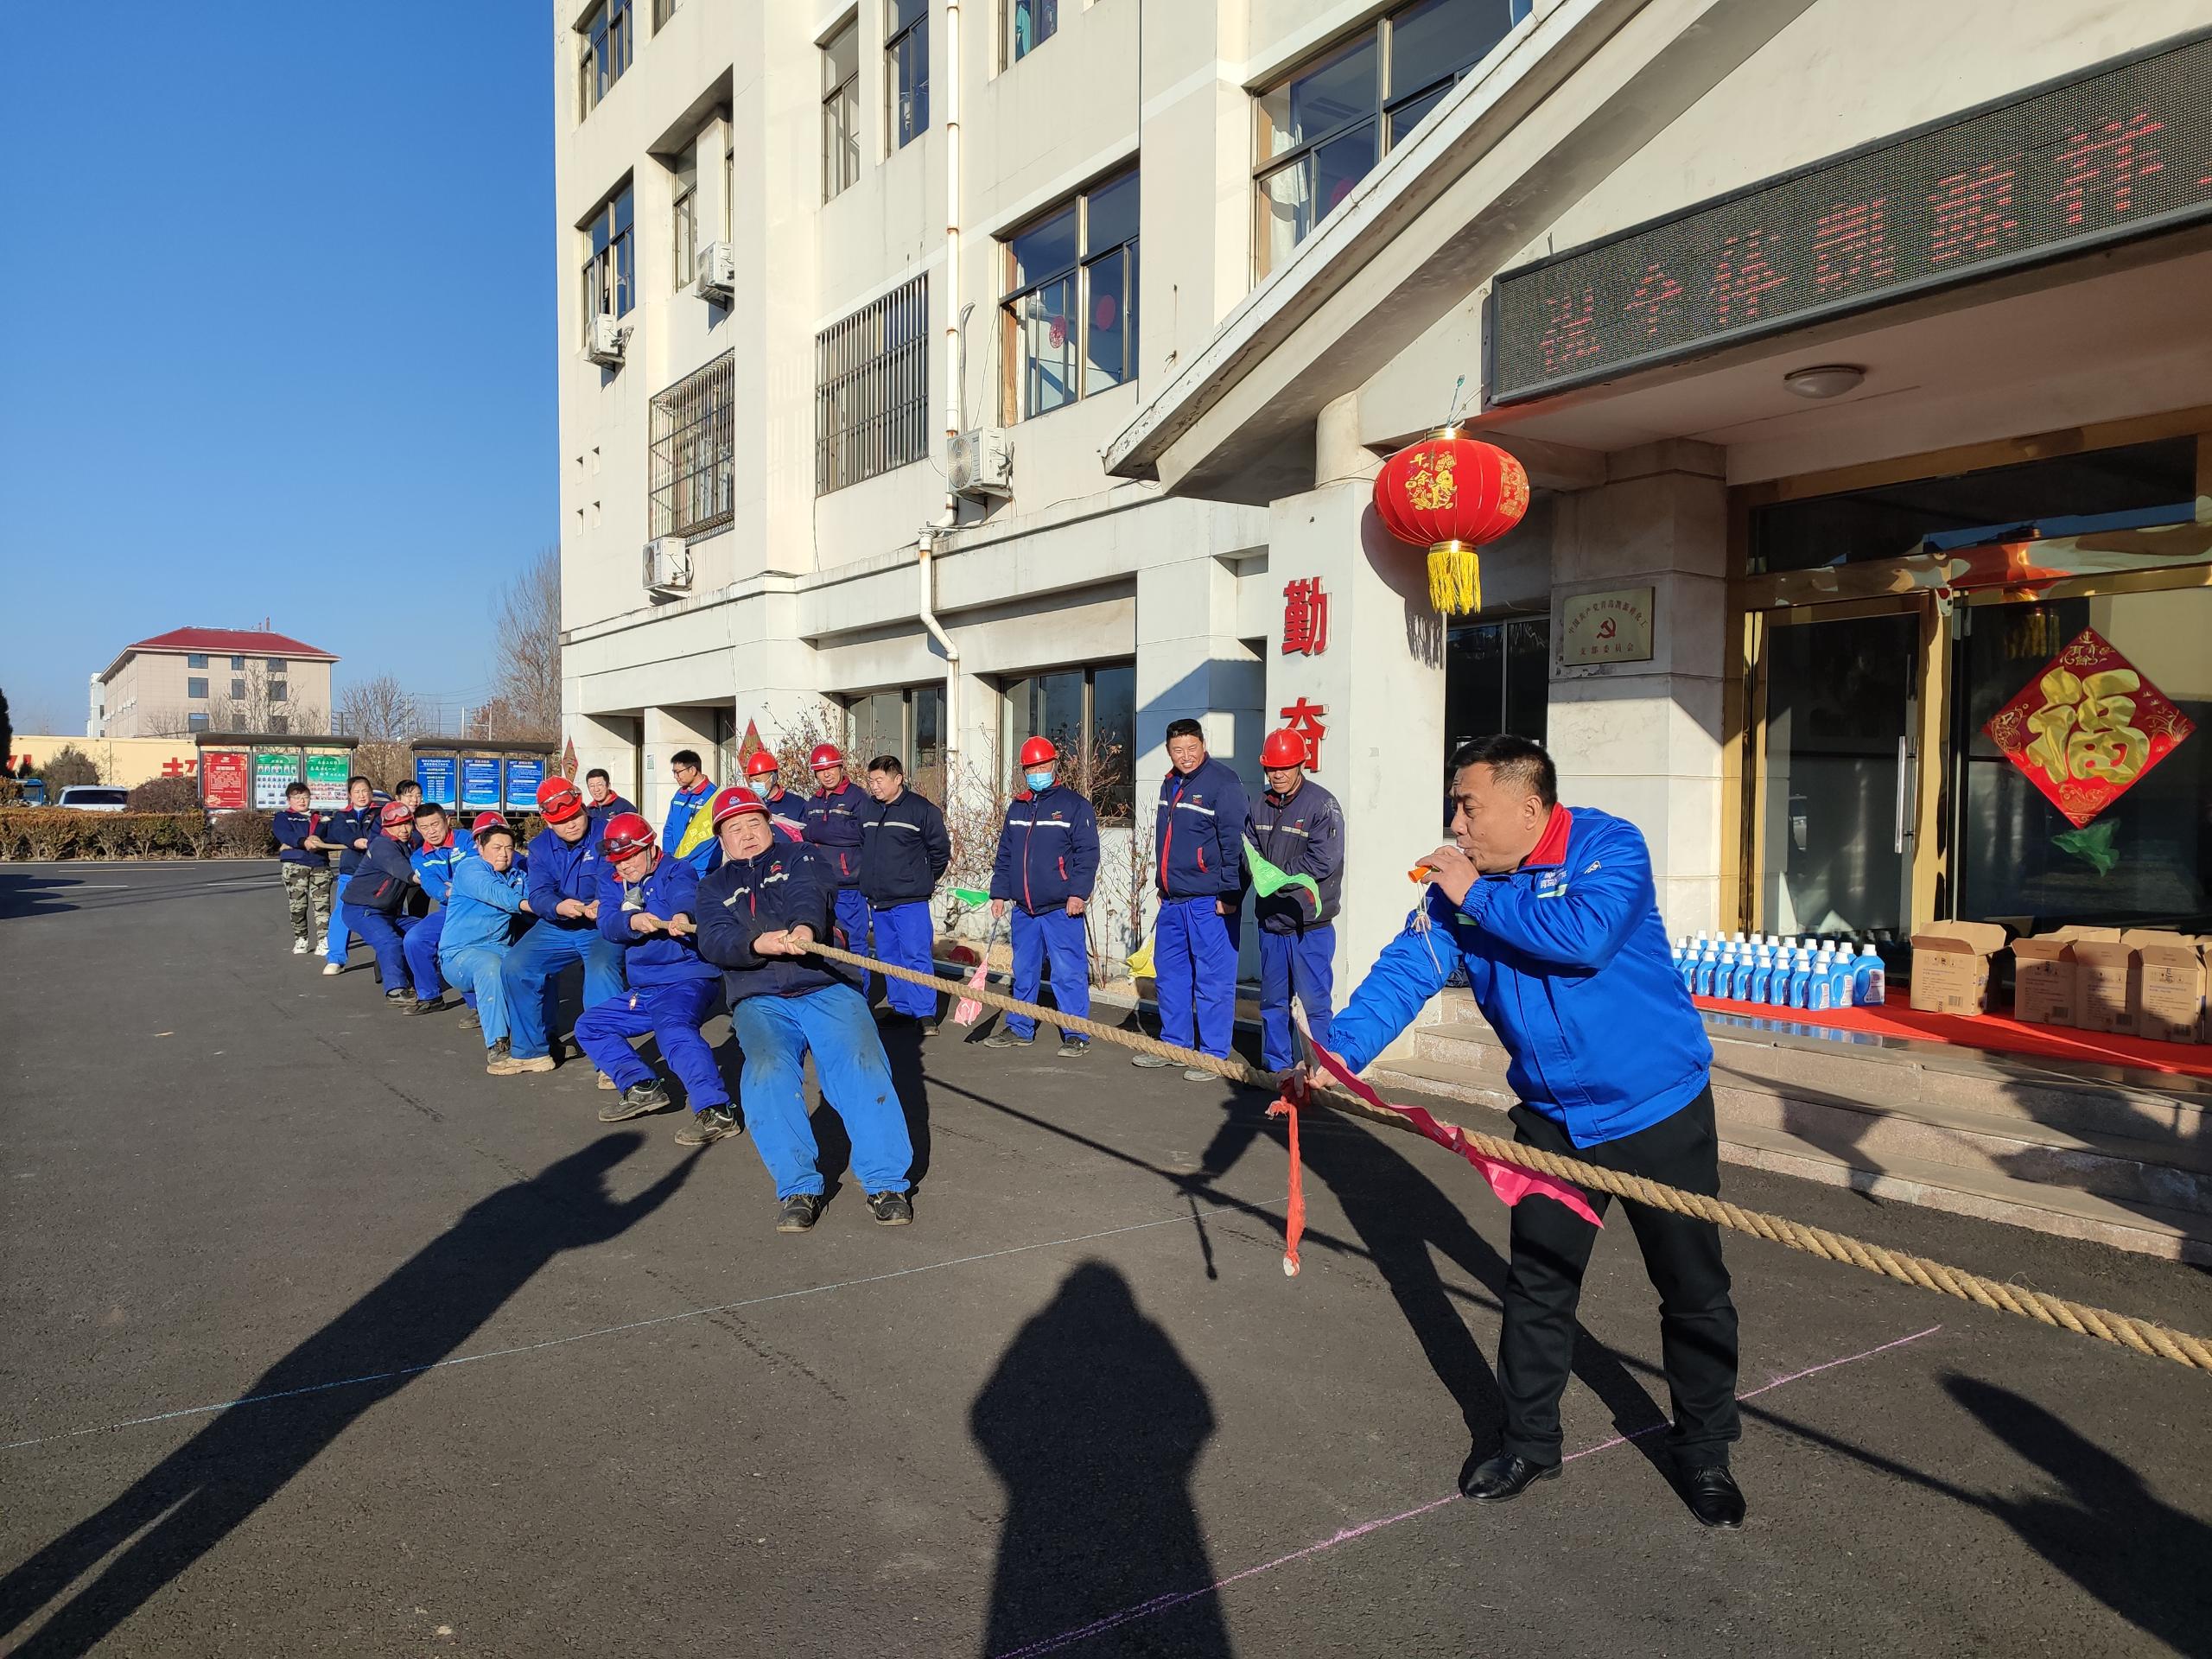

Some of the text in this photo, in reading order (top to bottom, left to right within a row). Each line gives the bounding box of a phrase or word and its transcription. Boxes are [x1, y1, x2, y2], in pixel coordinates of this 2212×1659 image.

[1580, 642, 1634, 656] 支部委员会
[2024, 664, 2152, 786] 福
